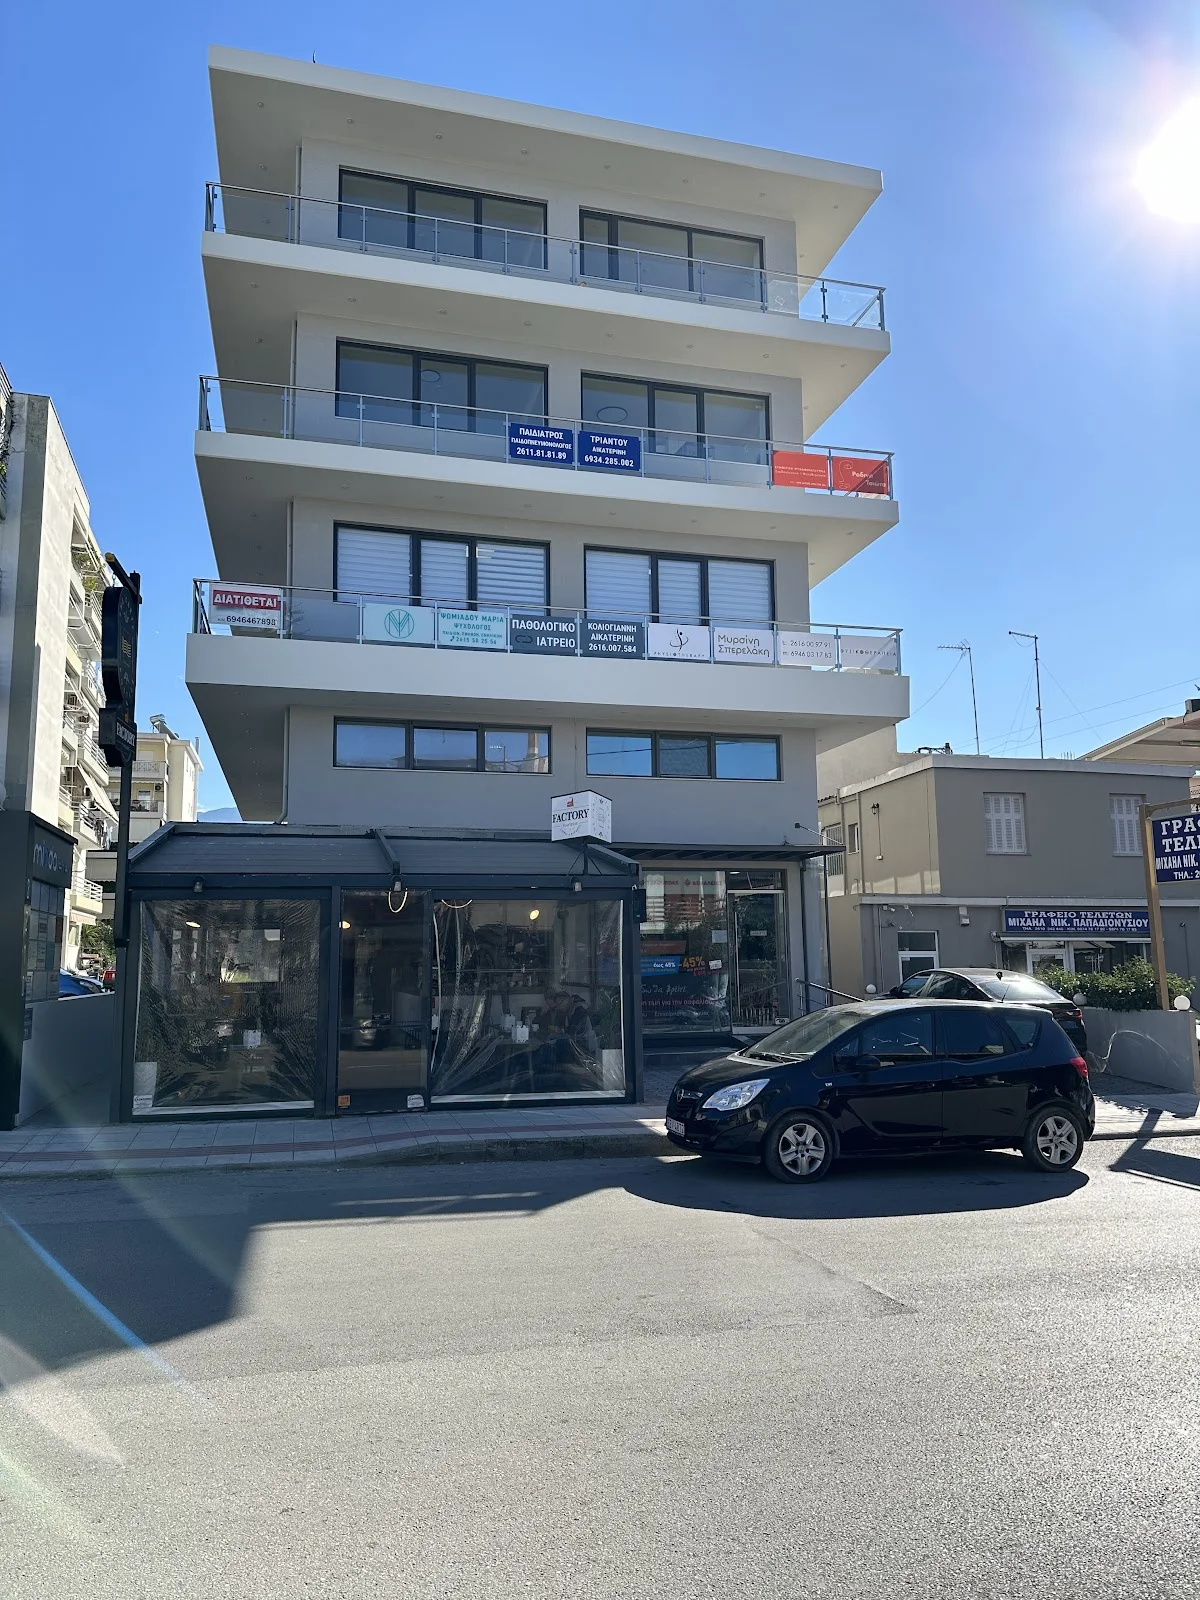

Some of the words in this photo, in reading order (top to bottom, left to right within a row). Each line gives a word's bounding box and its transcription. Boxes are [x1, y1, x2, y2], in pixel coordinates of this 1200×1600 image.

[519, 427, 564, 440] ΠΑΙΔΙΑΤΡΟΣ
[590, 435, 628, 447] ΤΡΙΑΝΤΟΥ
[516, 446, 567, 460] 2611.81.81.89
[592, 446, 626, 456] ΑΙΚΑΤΕΡΙΝΗ
[584, 454, 634, 467] 6934.285.002
[213, 593, 278, 608] ΔΙΑΤΙΘΕΤΑΙ
[440, 612, 479, 621] ΨΩΜΙΑΔΟΥ
[481, 615, 505, 623] ΜΑΡΙΑ
[453, 622, 492, 631] ΨΥΧΟΛΟΓΟΣ
[511, 619, 576, 633] ΠΑΘΟΛΟΓΙΚΟ
[587, 622, 637, 633] ΚΟΛΙΟΓΙΑΝΝΗ
[536, 636, 576, 649] ΙΑΤΡΕΙΟ
[590, 633, 635, 643] ΑΙΚΑΤΕΡΙΝΗ
[717, 634, 760, 647] Μυρσίνη
[588, 643, 637, 653] 2616.007.584
[718, 644, 770, 658] Σπερελάκη
[552, 808, 590, 824] FACTORY
[1161, 817, 1200, 836] ΓΡΑ
[1155, 855, 1182, 870] ΜΙΧΑΗΛ
[1183, 853, 1199, 868] ΝΙΚ.
[1079, 911, 1133, 919] ΤΕΛΕΤΩΝ
[1008, 917, 1046, 927] ΜΙΧΑΗΛ
[1050, 918, 1071, 927] ΝΙΚ.
[1073, 918, 1149, 928] ΠΑΠΑΔΙΟΝΥΣΙΟΥ
